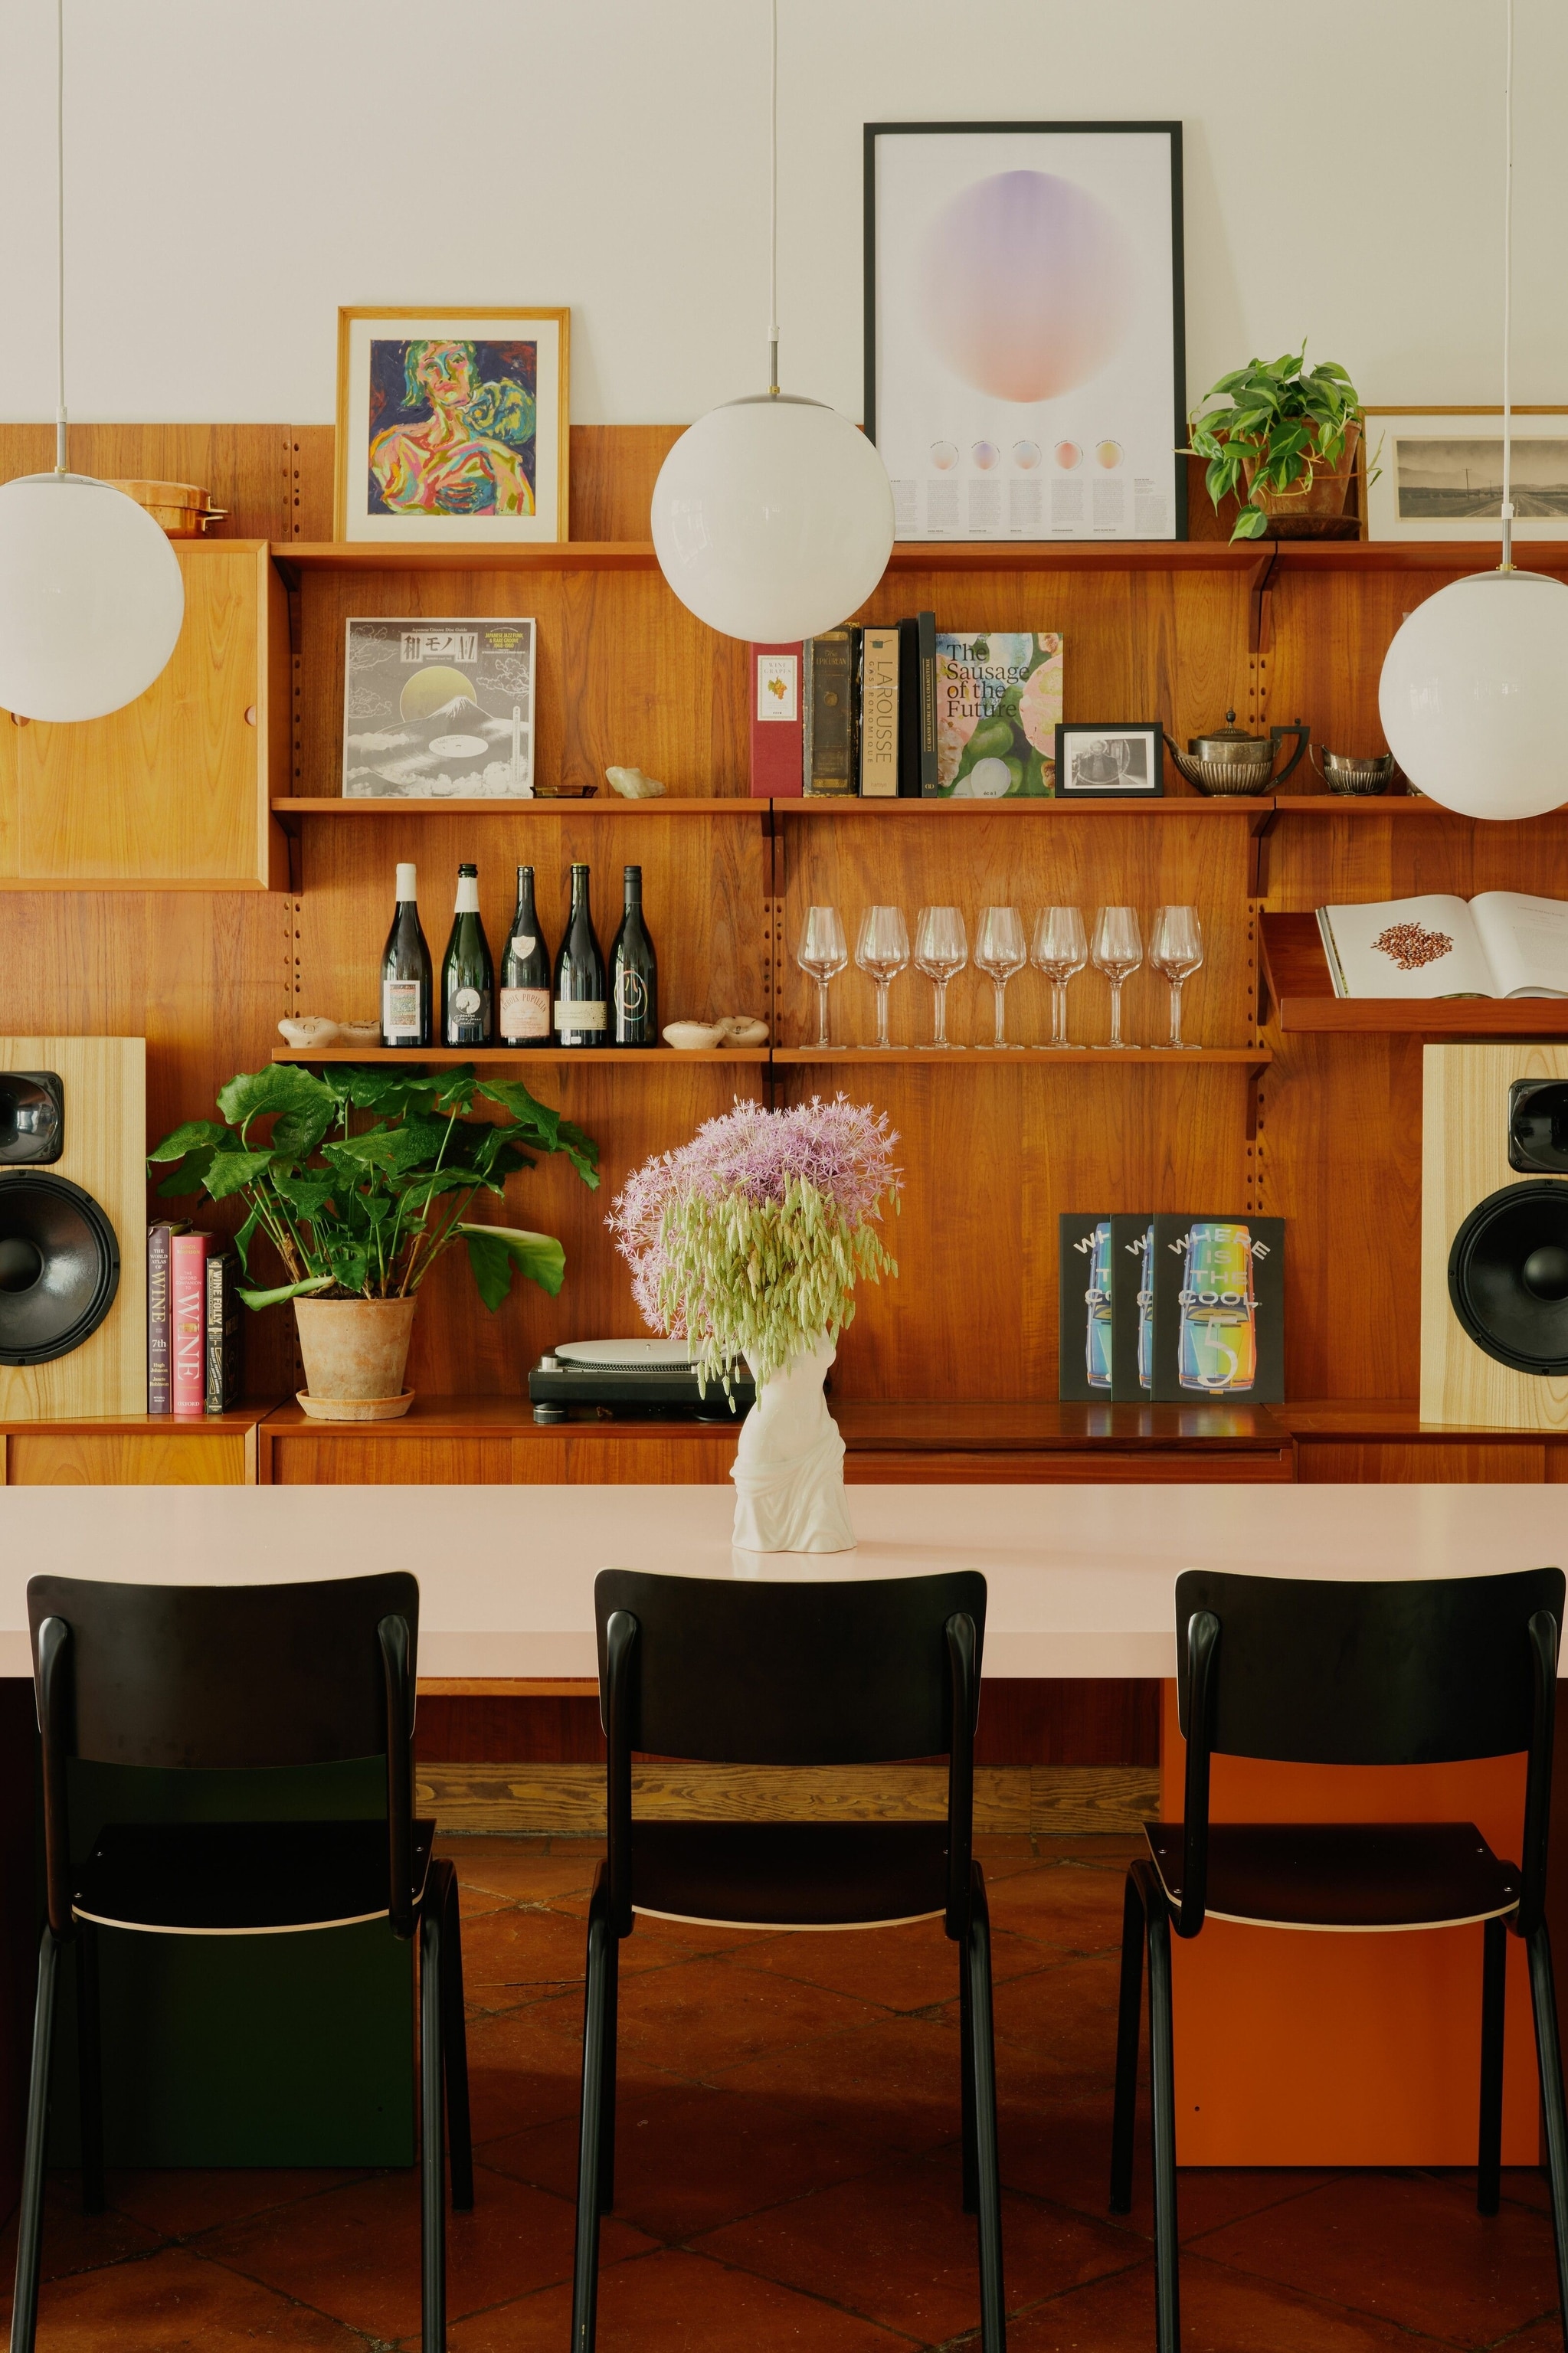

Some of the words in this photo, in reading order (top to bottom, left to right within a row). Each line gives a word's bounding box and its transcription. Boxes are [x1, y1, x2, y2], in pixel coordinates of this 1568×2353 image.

[947, 643, 987, 661] The
[947, 663, 1030, 684] Sausage
[947, 680, 968, 699] of
[973, 681, 1007, 699] the
[876, 661, 893, 763] LAROUSSE
[947, 700, 1017, 718] Future
[502, 994, 519, 1011] ARBOIS
[522, 993, 546, 1013] PUPILLIN
[1168, 1228, 1271, 1260] WHERE
[1206, 1250, 1232, 1265] IS
[213, 1270, 222, 1296] WINE
[1190, 1269, 1248, 1285] THE
[152, 1270, 165, 1323] WINE
[213, 1297, 222, 1325] FOLLY
[152, 1339, 166, 1347] 7th
[177, 1291, 200, 1380] WINE
[1197, 1317, 1239, 1387] 5
